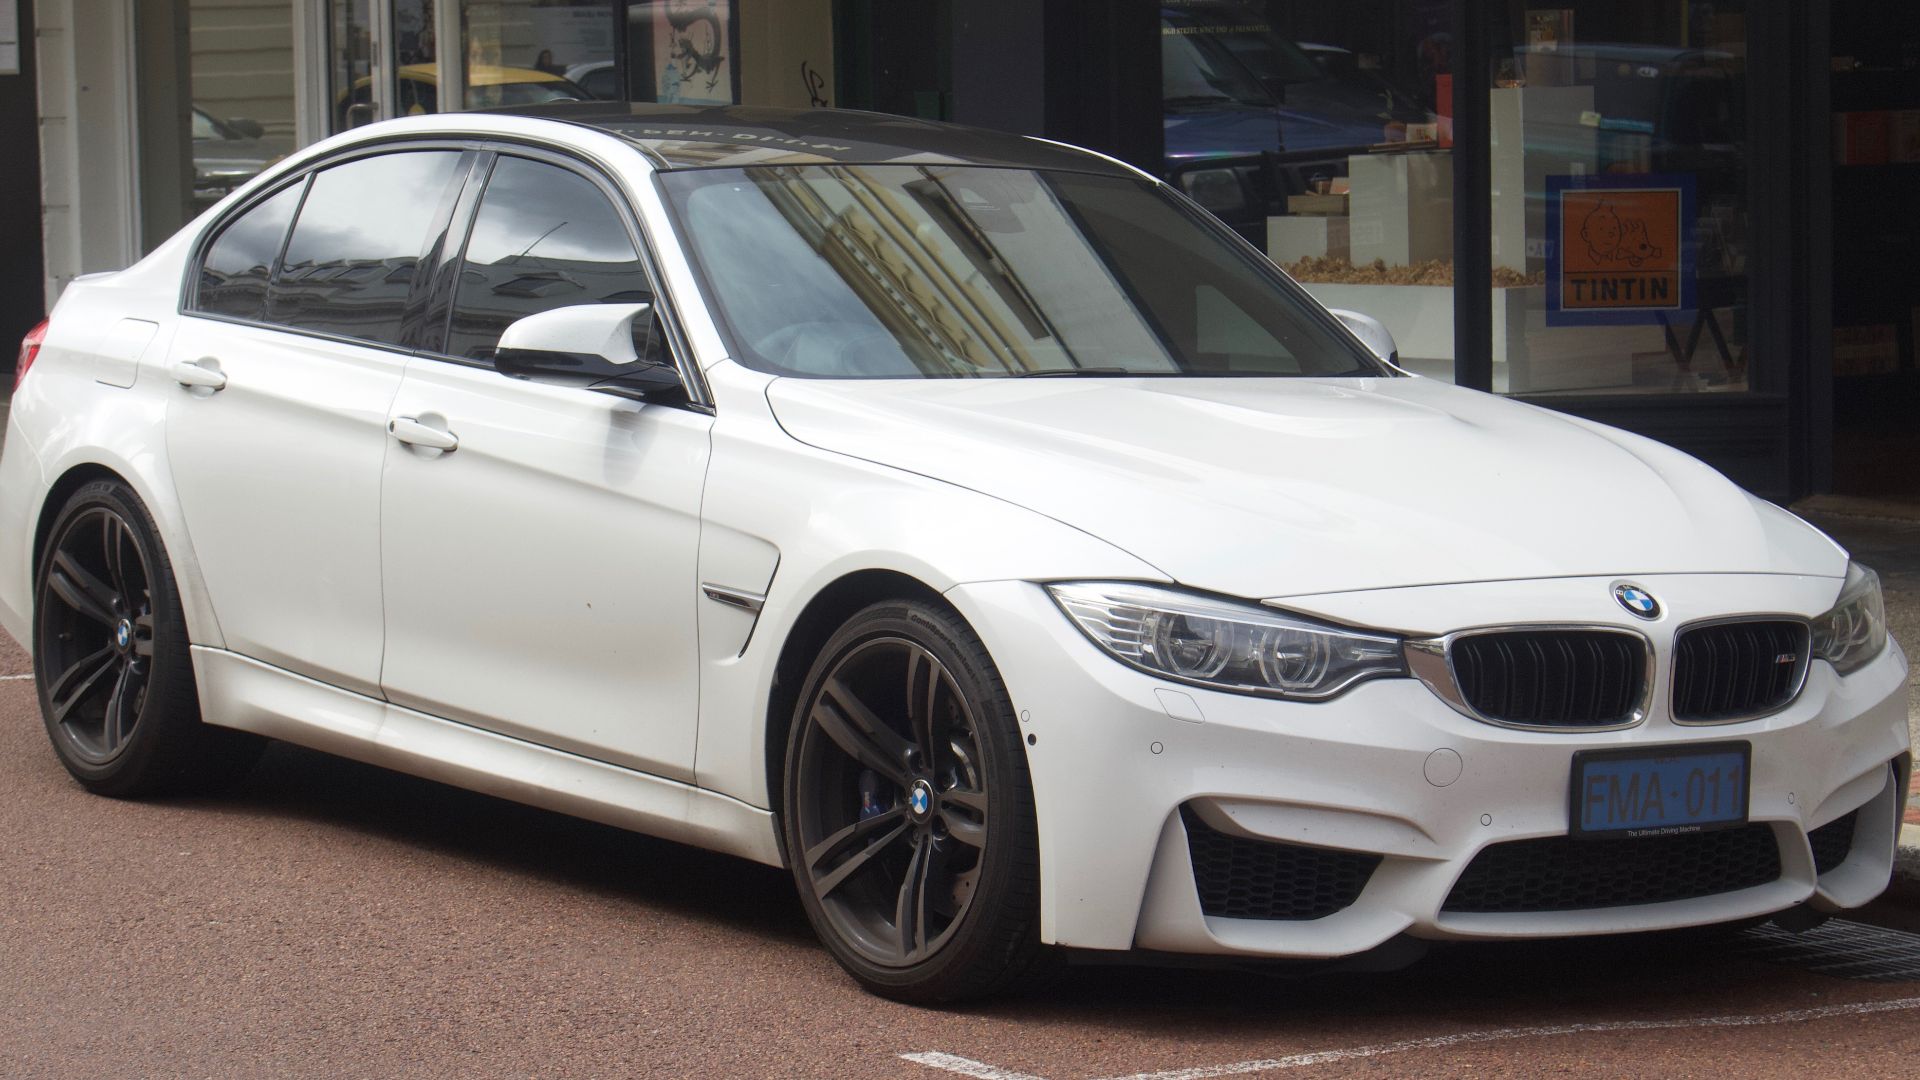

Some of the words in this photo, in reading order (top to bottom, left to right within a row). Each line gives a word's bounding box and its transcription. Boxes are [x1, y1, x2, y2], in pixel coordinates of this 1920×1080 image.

[1571, 277, 1669, 301] TINTIN
[1660, 827, 1679, 835] Driving
[1679, 825, 1701, 833] Machine
